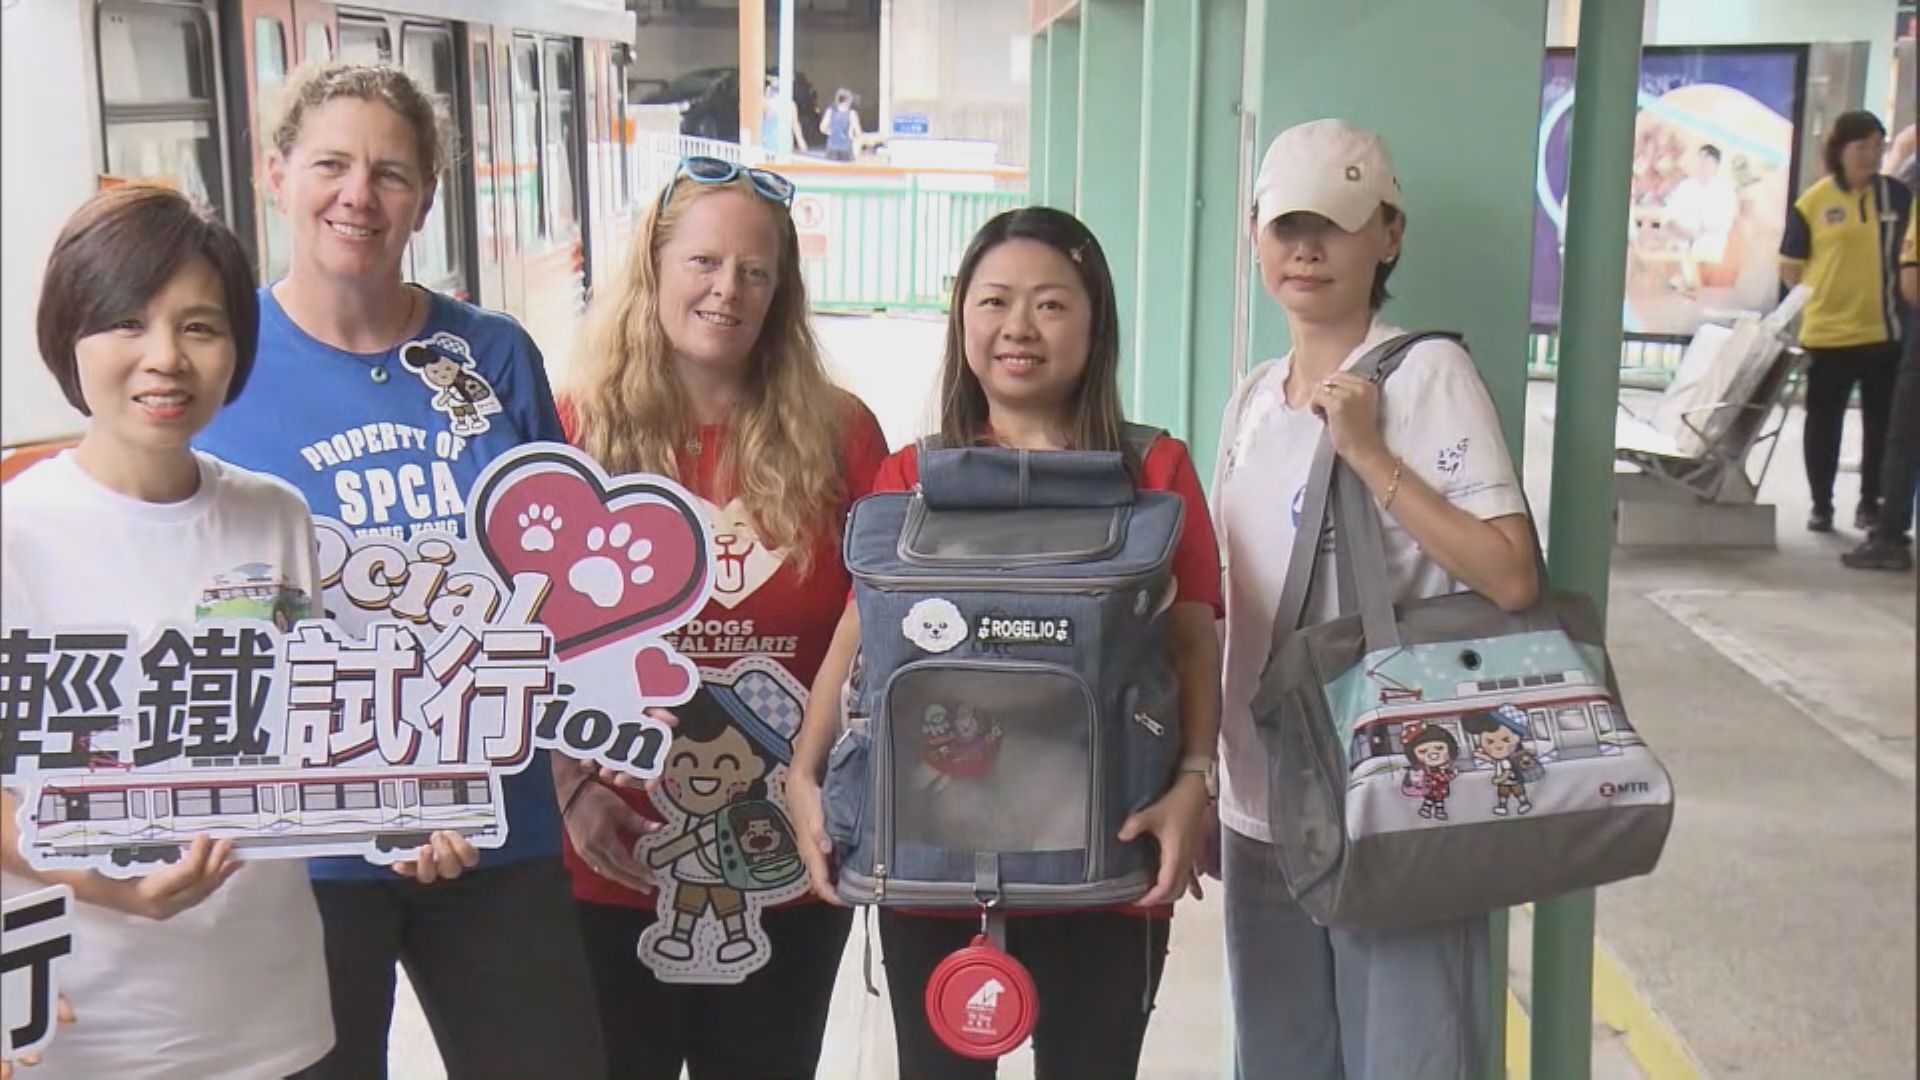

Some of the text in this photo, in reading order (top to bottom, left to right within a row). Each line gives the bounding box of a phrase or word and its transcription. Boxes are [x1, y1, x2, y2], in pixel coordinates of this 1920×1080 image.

[301, 423, 466, 471] PROPERTY OF
[335, 461, 465, 525] SPCA
[687, 620, 754, 635] DOGS
[991, 619, 1055, 638] ROGELIO
[714, 636, 798, 651] HEARTS
[0, 626, 556, 774] 輕鐵試行
[1617, 781, 1649, 793] MTR
